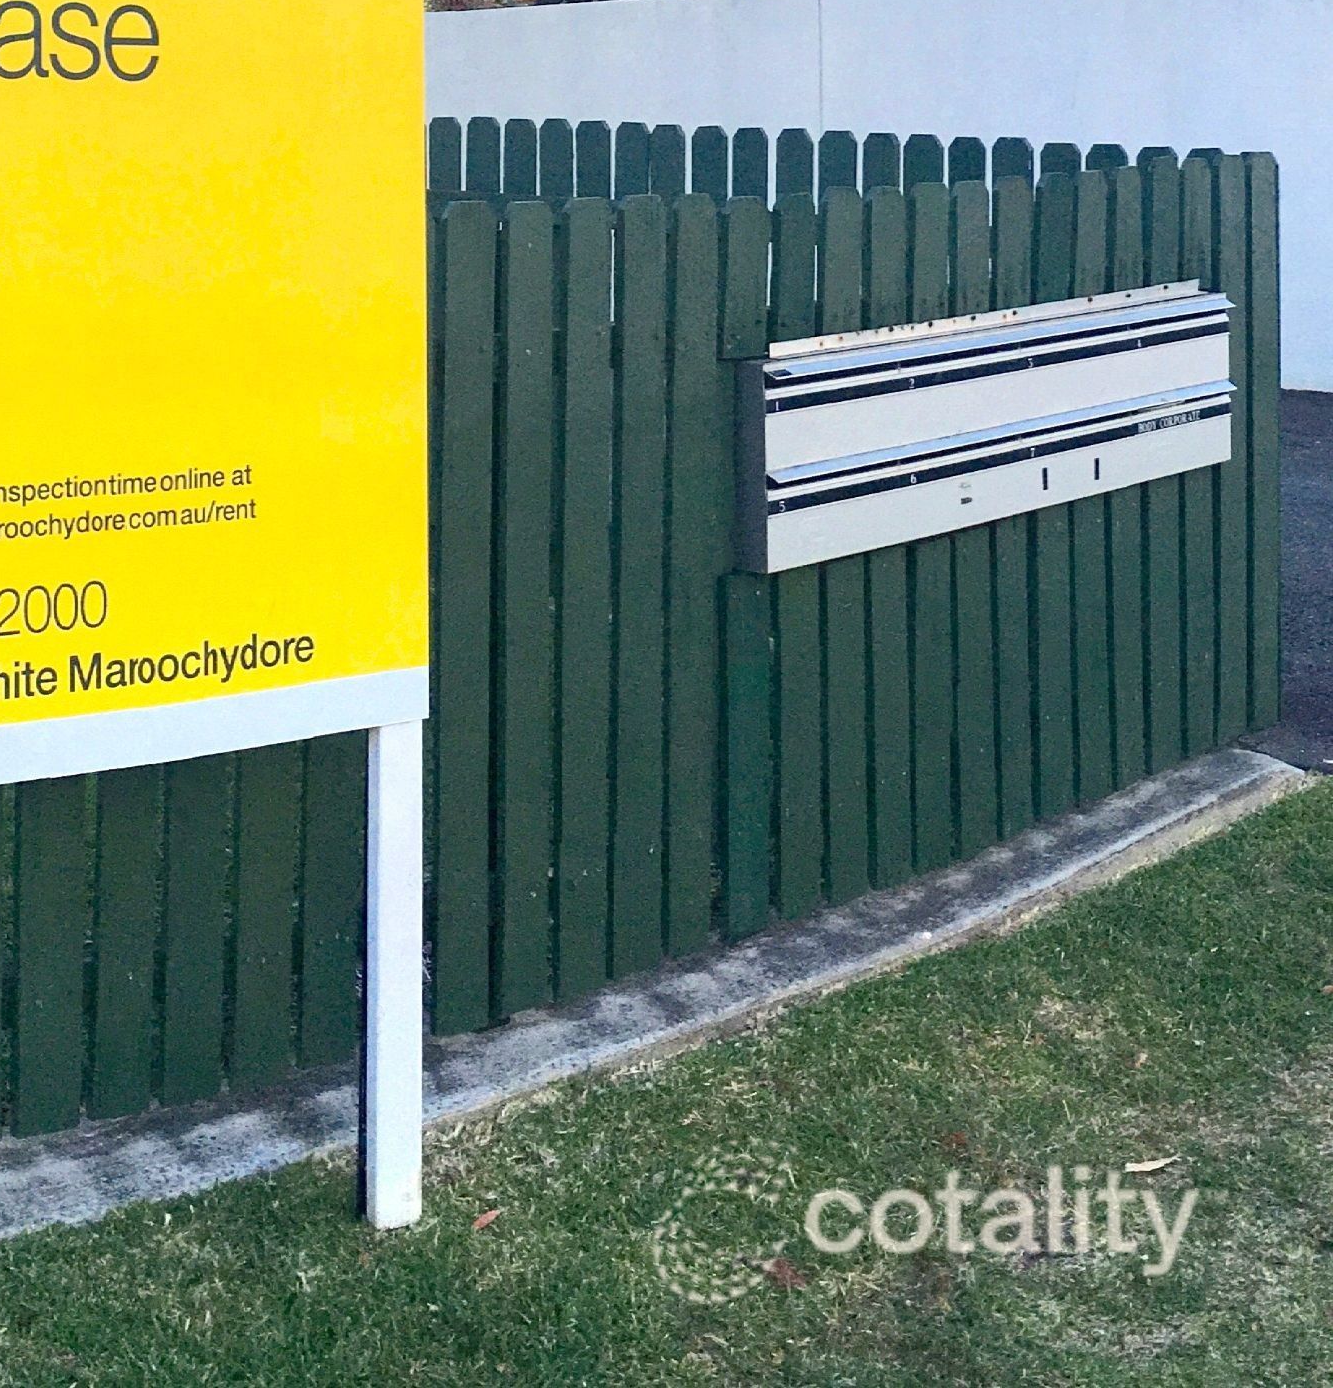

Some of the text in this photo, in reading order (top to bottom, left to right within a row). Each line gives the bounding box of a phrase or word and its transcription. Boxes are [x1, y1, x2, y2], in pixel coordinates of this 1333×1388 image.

[908, 378, 915, 390] 2
[775, 401, 780, 412] 1
[1137, 410, 1201, 433] BODY CORPORATE
[231, 464, 252, 486] at
[910, 473, 917, 484] 6
[778, 501, 786, 512] 5
[69, 633, 315, 693] Maroochydore
